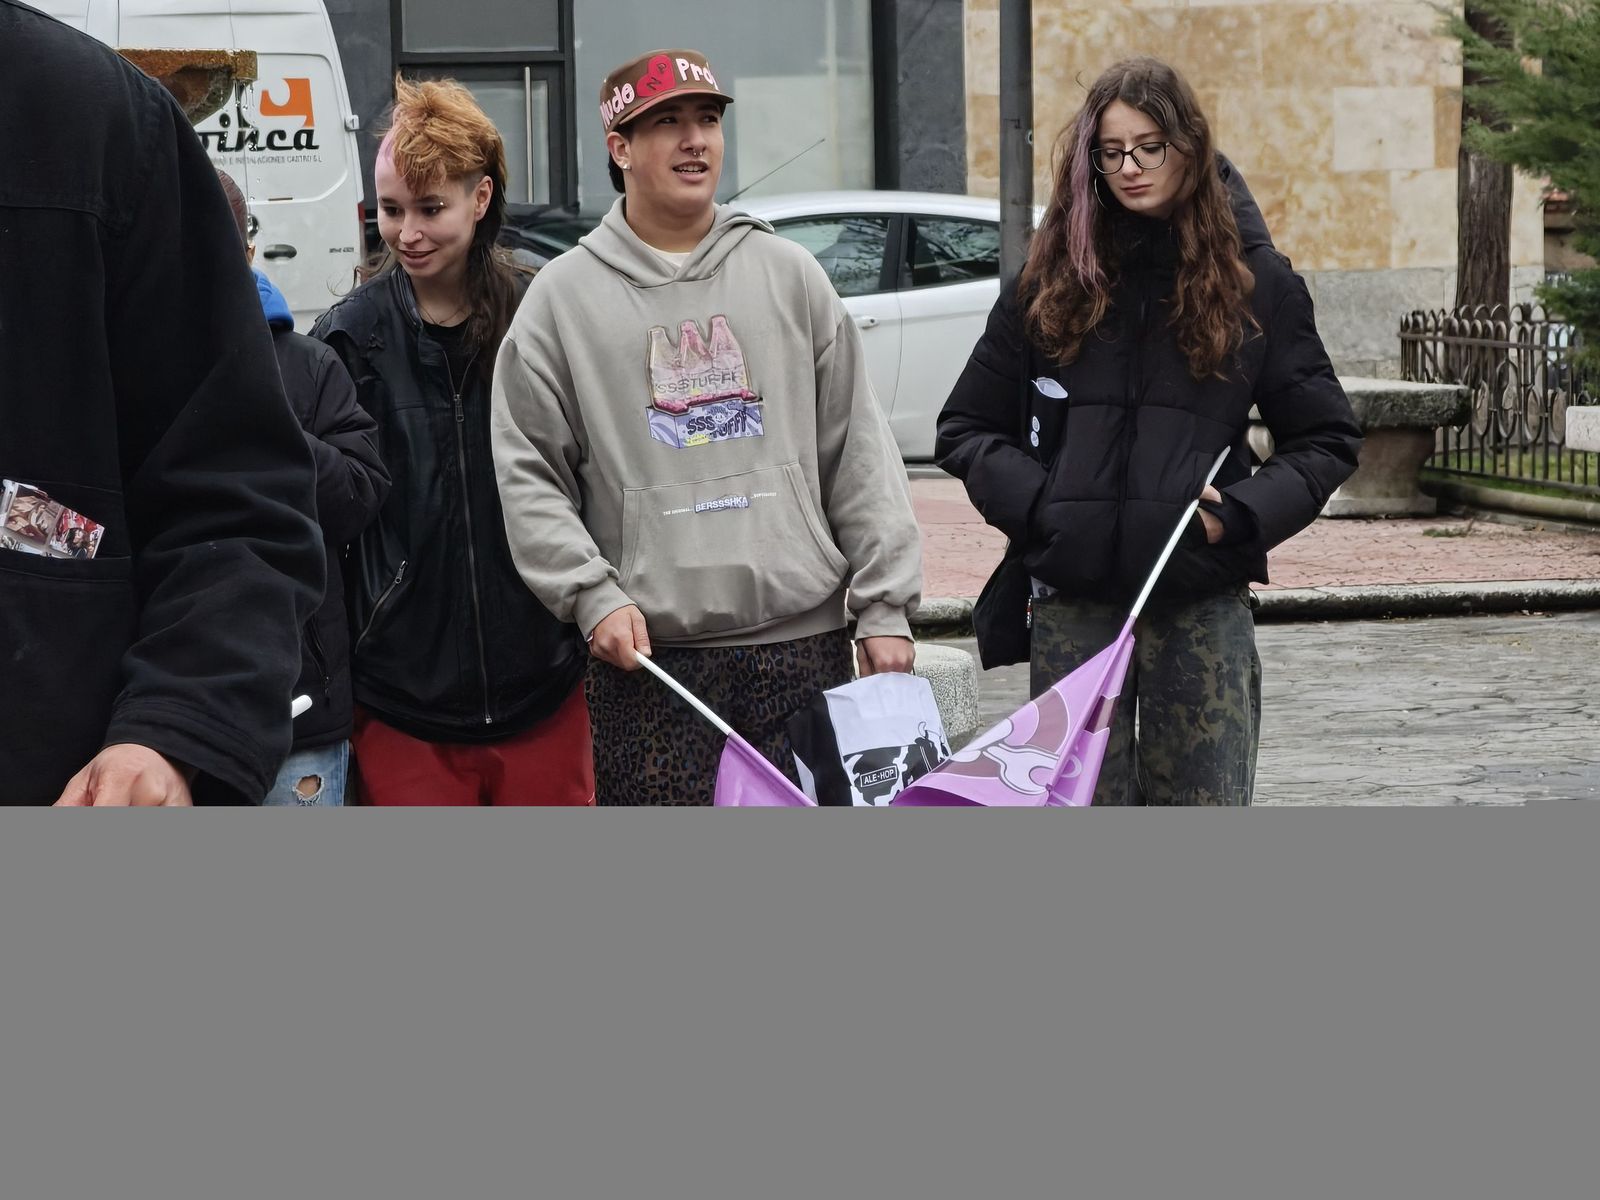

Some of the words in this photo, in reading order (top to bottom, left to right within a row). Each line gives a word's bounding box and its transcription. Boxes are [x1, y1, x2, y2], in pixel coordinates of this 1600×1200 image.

[600, 83, 635, 129] Nude
[686, 415, 716, 435] SSS
[695, 496, 749, 512] BERSSSHKA
